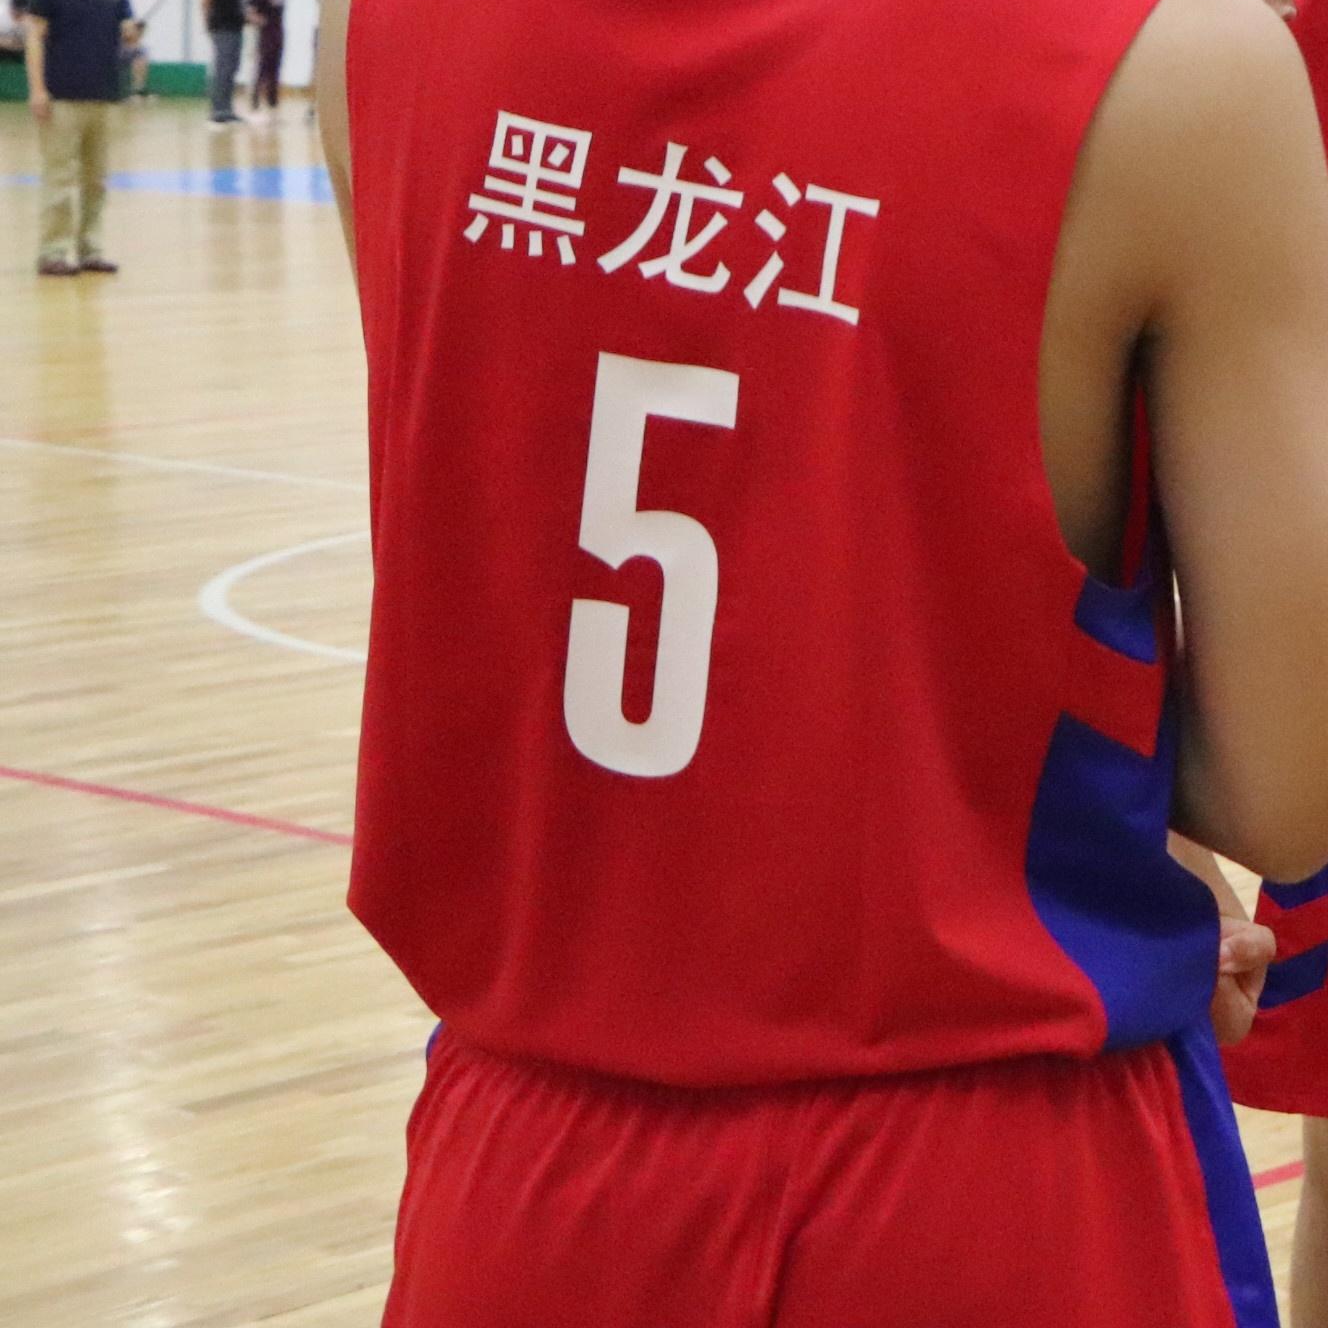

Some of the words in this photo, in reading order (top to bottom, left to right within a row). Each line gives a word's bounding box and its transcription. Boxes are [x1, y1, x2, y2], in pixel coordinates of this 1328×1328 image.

[463, 110, 881, 326] 黑龙江
[563, 351, 740, 777] 5
